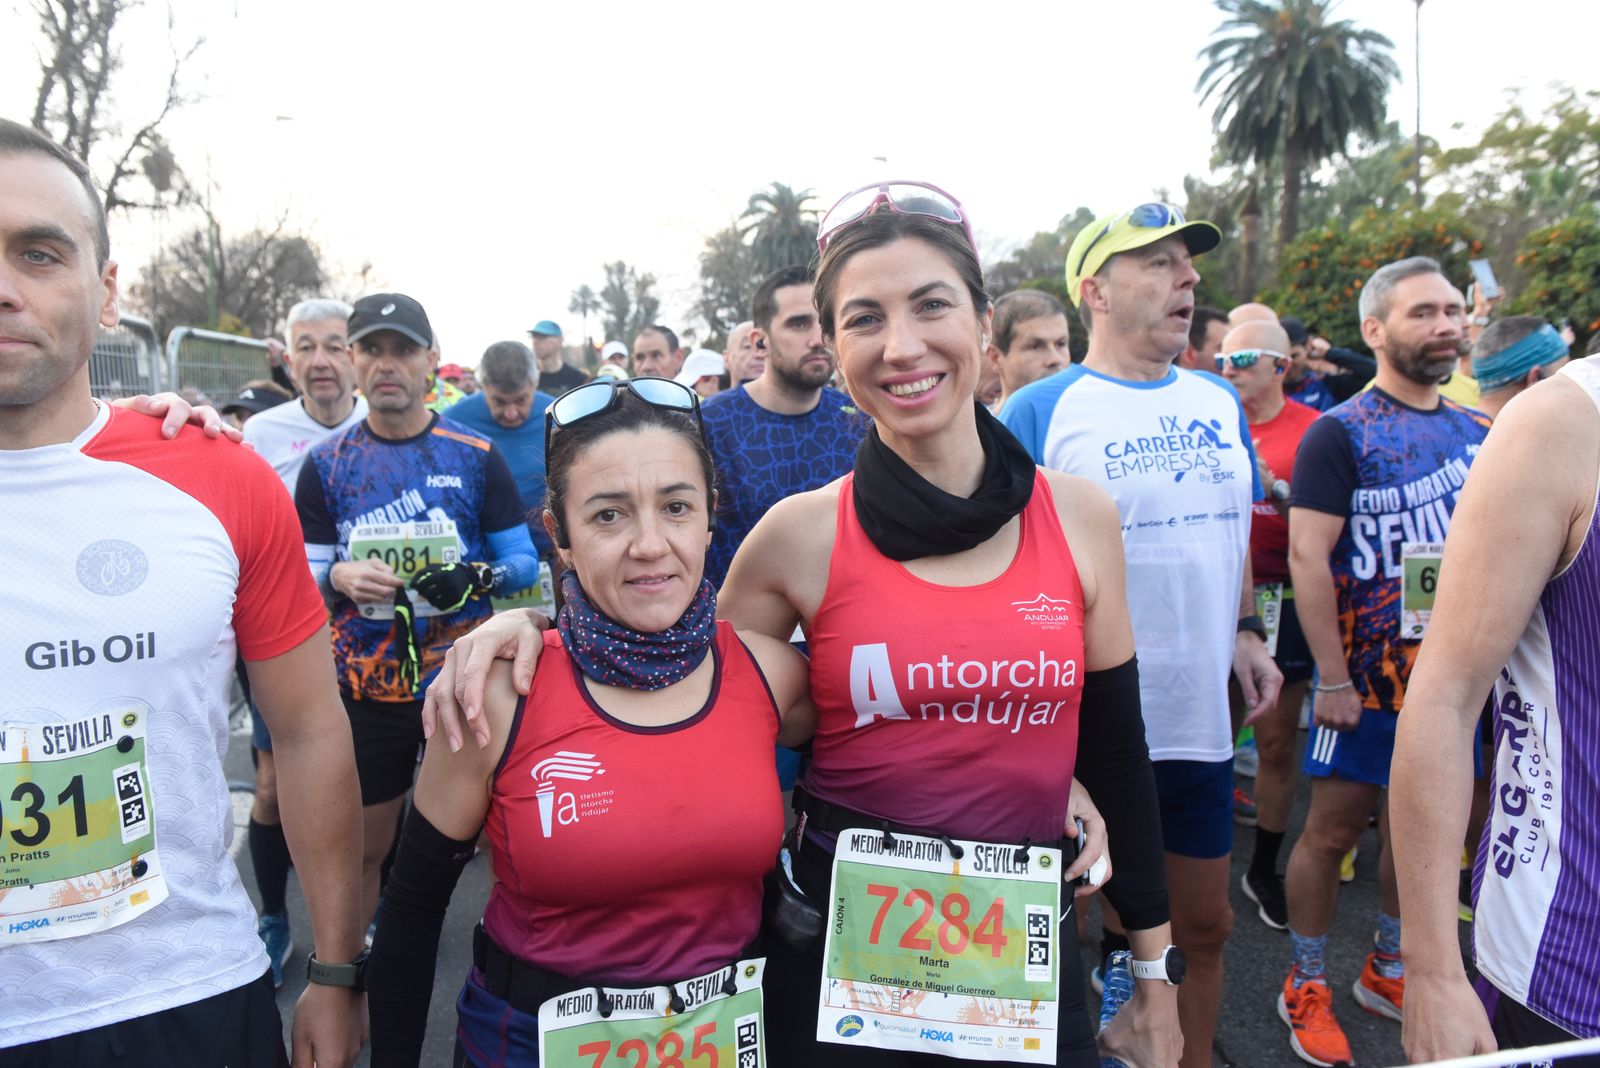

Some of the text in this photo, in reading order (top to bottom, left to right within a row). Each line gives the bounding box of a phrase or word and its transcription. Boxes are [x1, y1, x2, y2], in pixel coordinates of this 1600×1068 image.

[1159, 415, 1183, 433] IX
[1104, 433, 1212, 459] CARRERA
[1104, 450, 1221, 481] EMPRESAS
[426, 474, 462, 489] HOKA
[25, 631, 156, 670] Gib Oil
[42, 713, 114, 756] SEVILLA
[0, 774, 89, 848] 31
[11, 850, 51, 863] Pratts
[850, 834, 884, 856] MEDIO
[889, 838, 943, 863] MARATÓN
[8, 917, 51, 934] HOKA
[835, 906, 845, 935] CAJÓN
[866, 883, 1008, 958] 7284
[919, 955, 950, 969] Marta
[869, 973, 996, 996] González de Miguel Guerrero
[926, 971, 941, 979] Marta
[556, 993, 593, 1018] MEDIO
[919, 1028, 954, 1043] HOKA
